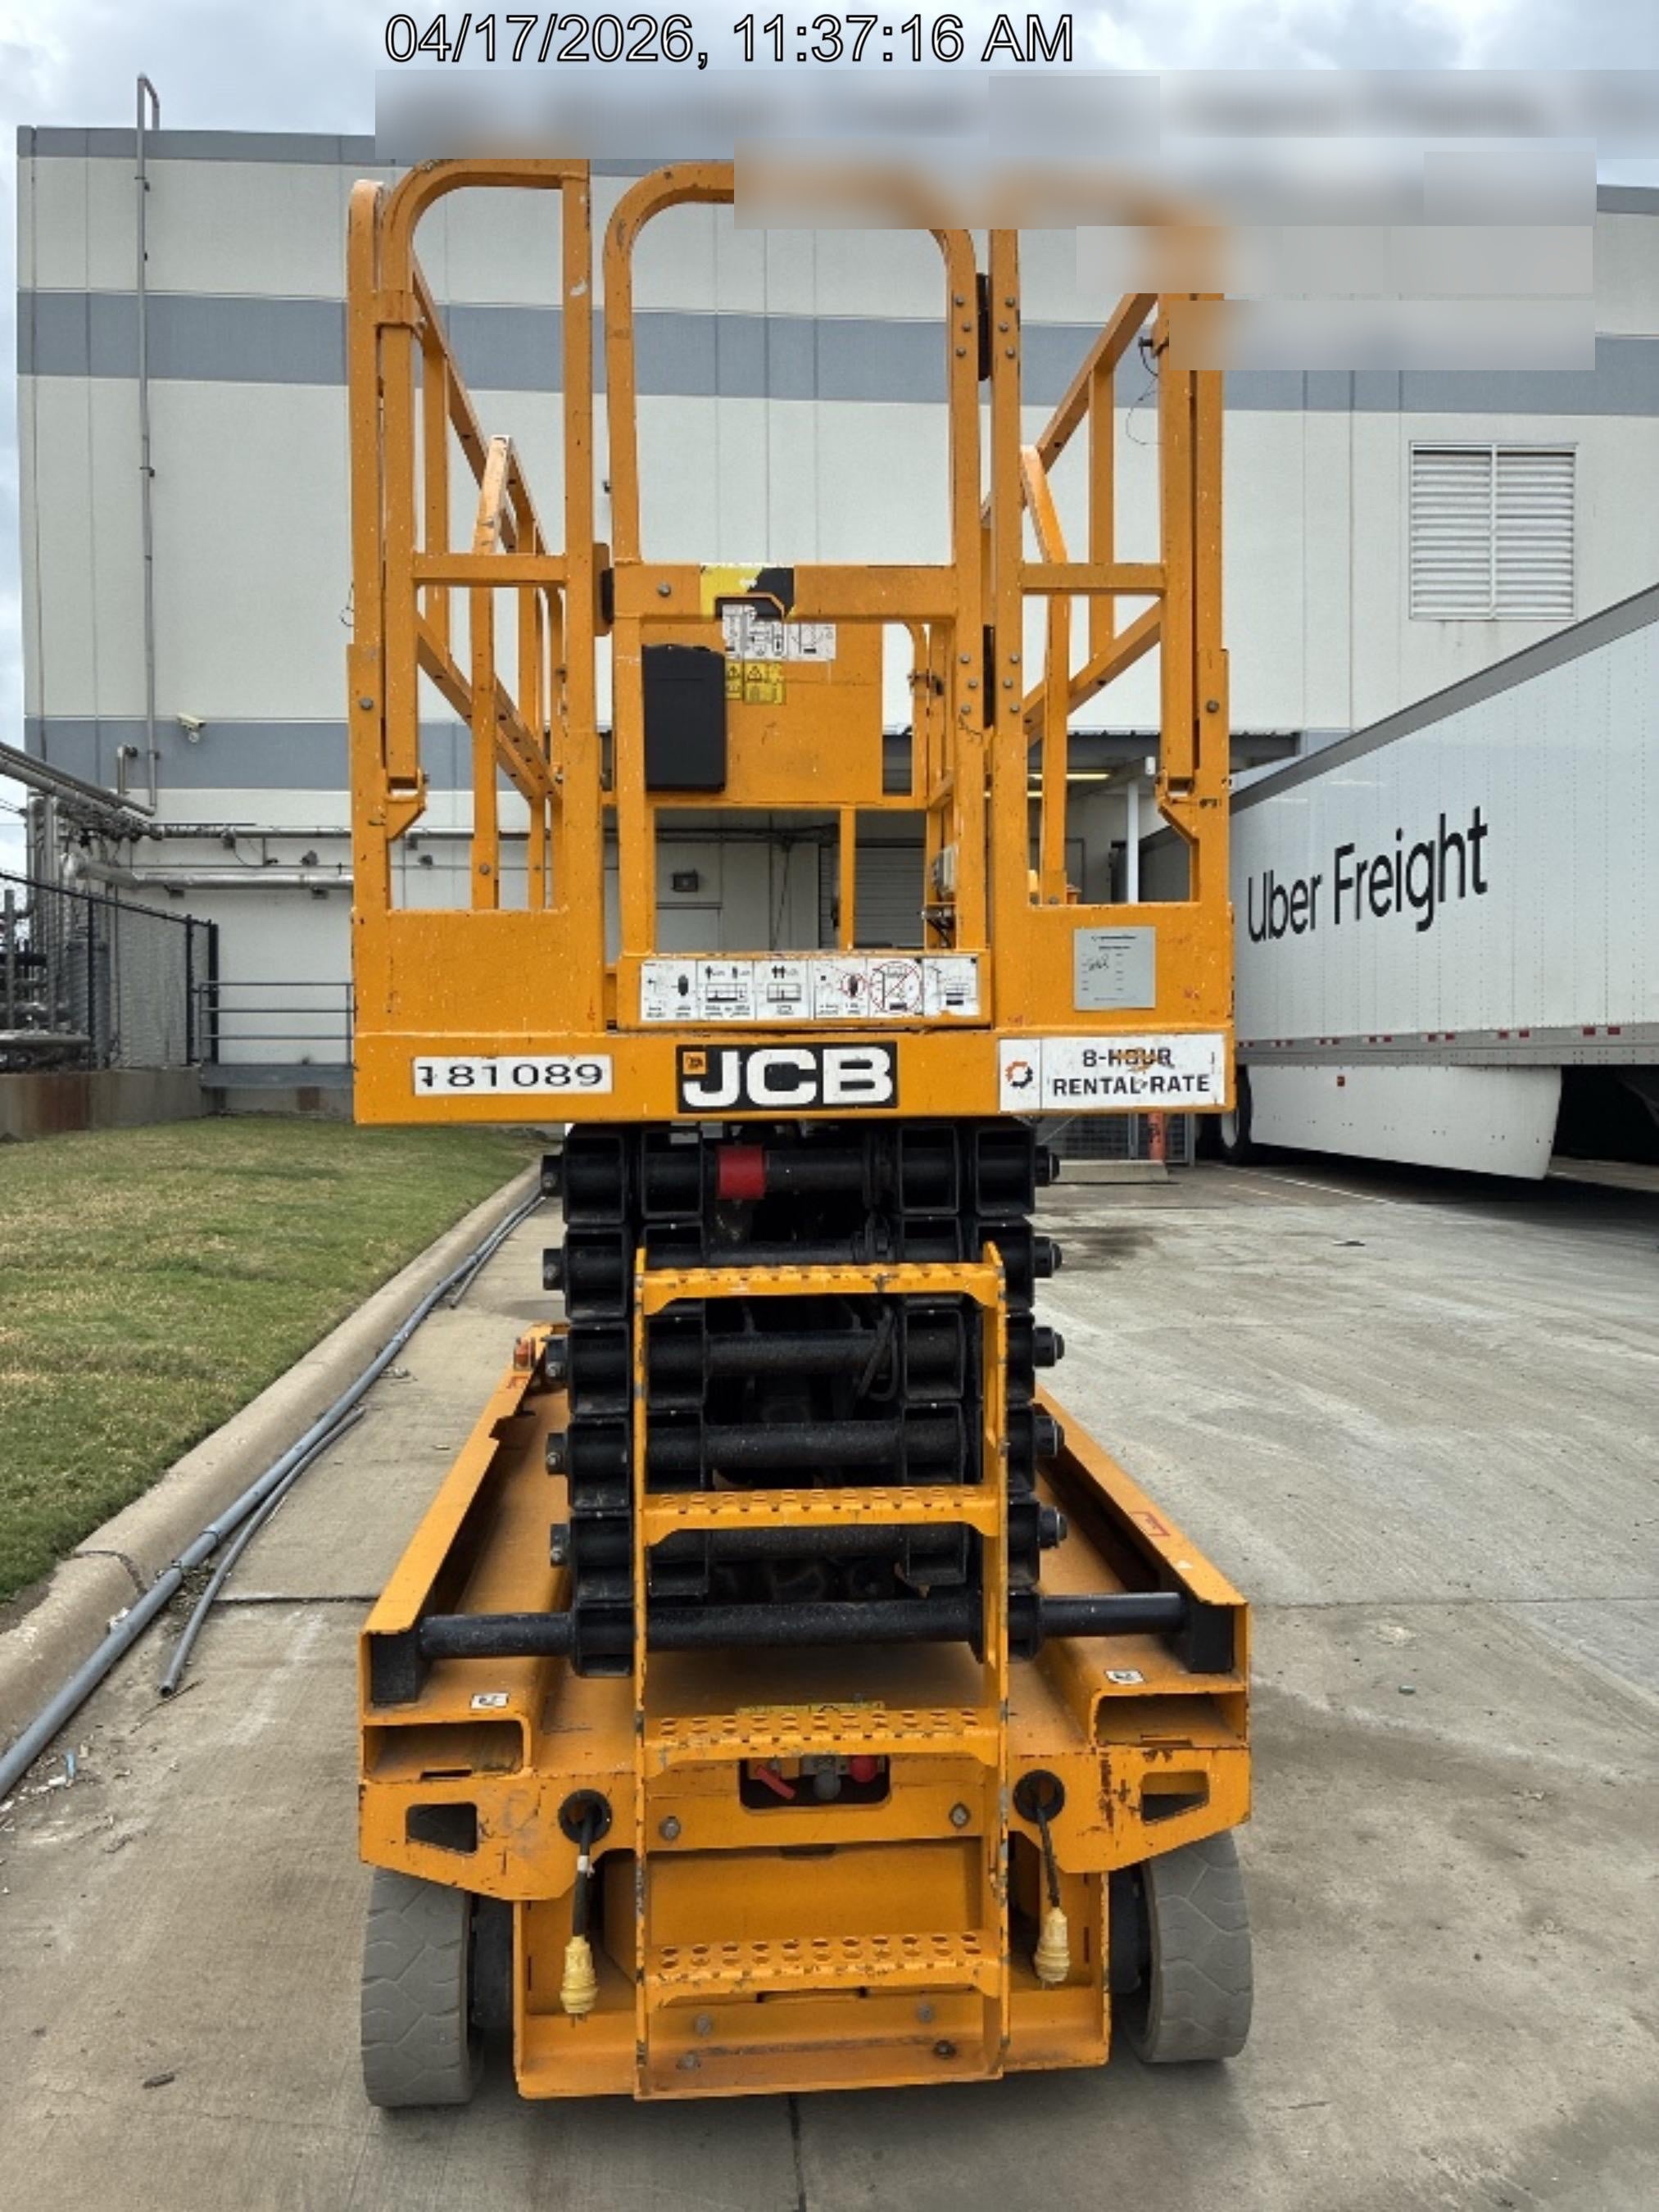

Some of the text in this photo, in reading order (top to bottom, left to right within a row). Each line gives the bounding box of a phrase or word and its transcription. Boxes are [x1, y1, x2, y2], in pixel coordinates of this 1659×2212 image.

[1248, 805, 1489, 944] Uber Freight
[1082, 1047, 1175, 1068] 8-HOUR
[417, 1061, 605, 1088] 181089
[682, 1046, 893, 1108] JCB
[1053, 1073, 1211, 1097] RENTAL RATE
